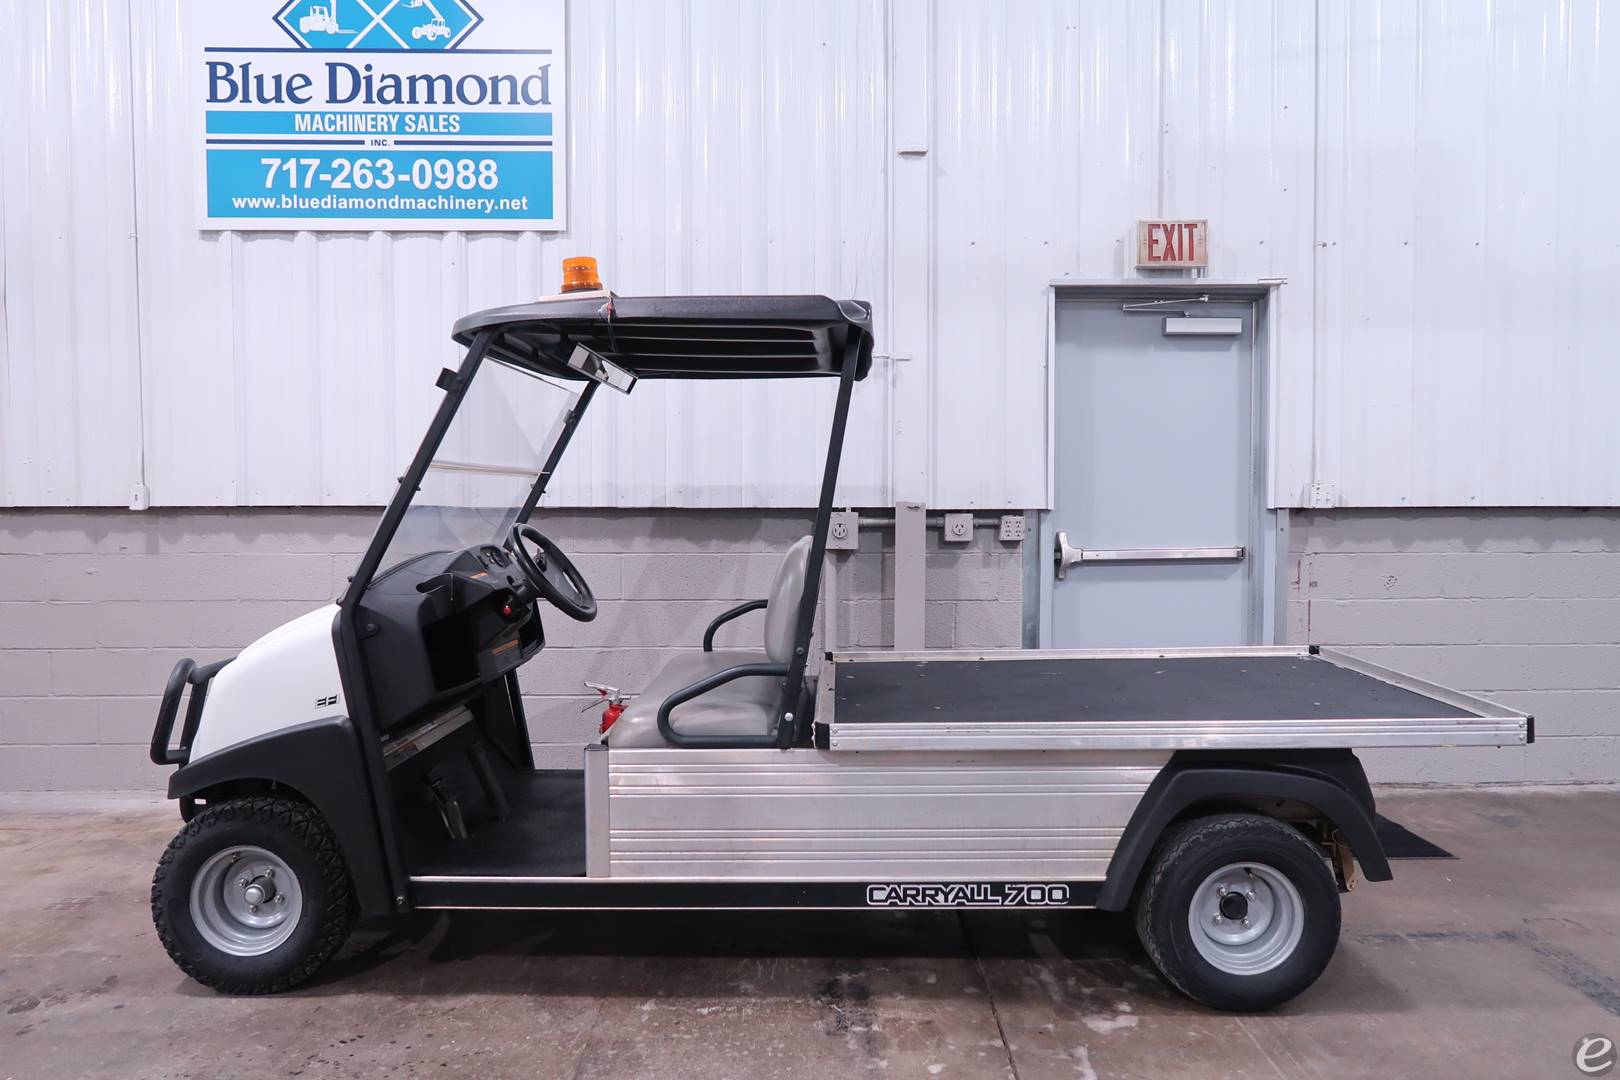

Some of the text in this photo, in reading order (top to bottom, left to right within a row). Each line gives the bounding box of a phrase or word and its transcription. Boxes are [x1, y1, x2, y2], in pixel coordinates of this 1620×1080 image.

[205, 61, 551, 106] Blue Diamond
[295, 113, 461, 133] MACHINERY SALES
[370, 139, 391, 147] INC.
[261, 157, 499, 190] 717-263-0988
[232, 194, 528, 213] www.bluediamondmachinery.net
[1147, 223, 1198, 261] EXIT
[866, 884, 1070, 906] CARRYALL 700
